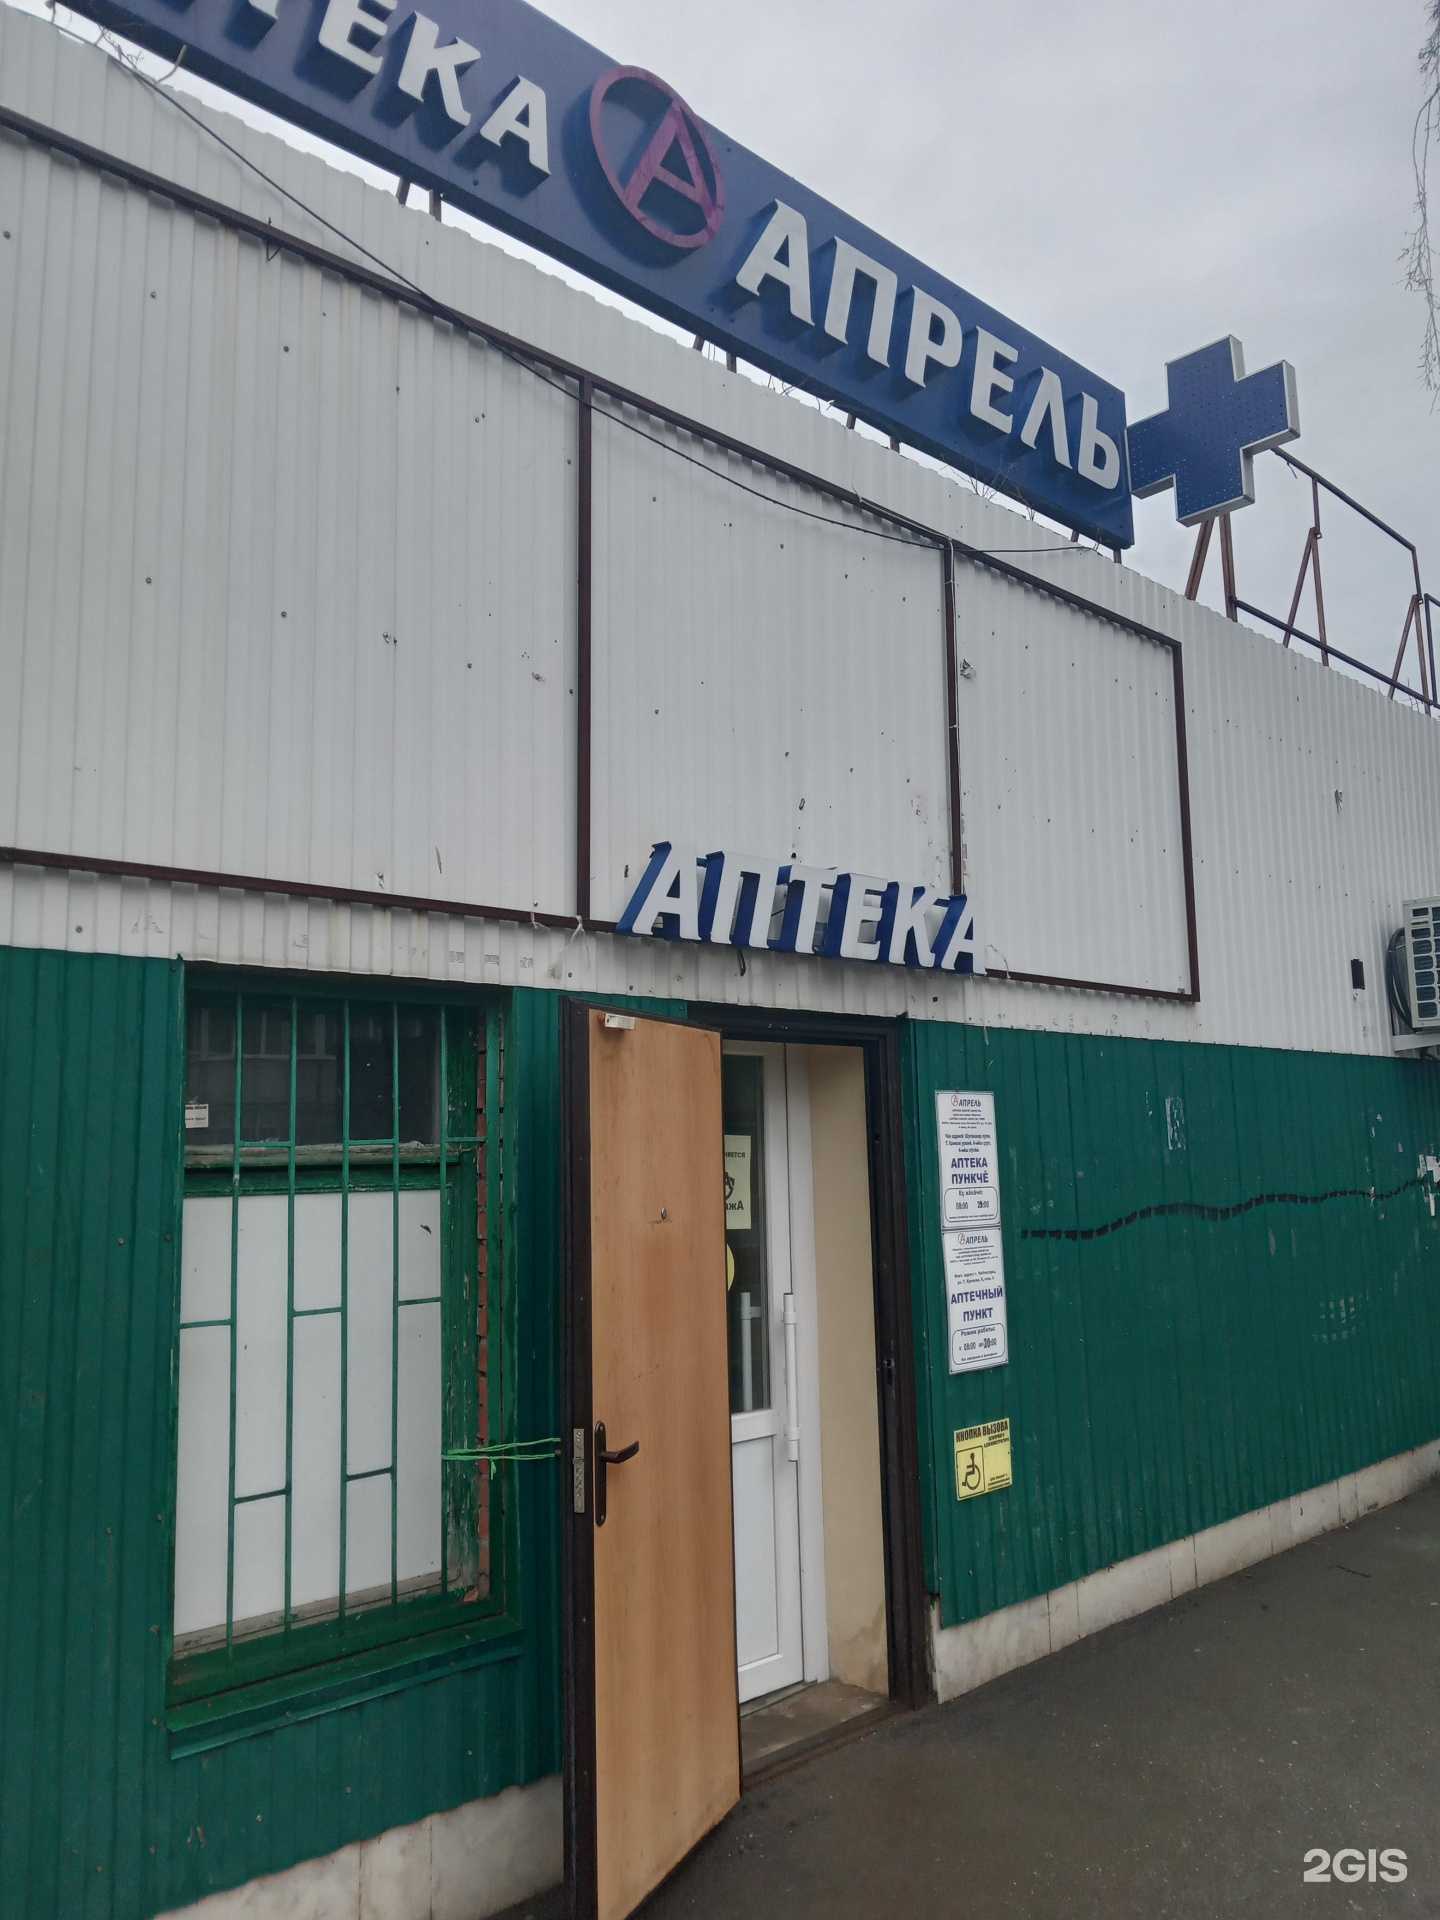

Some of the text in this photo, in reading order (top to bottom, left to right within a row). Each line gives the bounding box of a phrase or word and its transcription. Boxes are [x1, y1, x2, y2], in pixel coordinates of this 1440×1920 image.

[247, 0, 552, 175] ЕКА
[736, 199, 1121, 490] АПРЕЛЬ
[618, 842, 987, 975] АПТЕКА
[959, 1098, 982, 1107] АПРЕЛЬ
[951, 1157, 988, 1169] АПТЕКА
[965, 1235, 989, 1245] АПРЕЛЬ
[951, 1285, 1003, 1304] АПТЕЧНЫЙ
[963, 1307, 993, 1322] ПУНКТ
[955, 1427, 981, 1443] КНОПКА
[982, 1420, 1009, 1437] ВЫЗОВА
